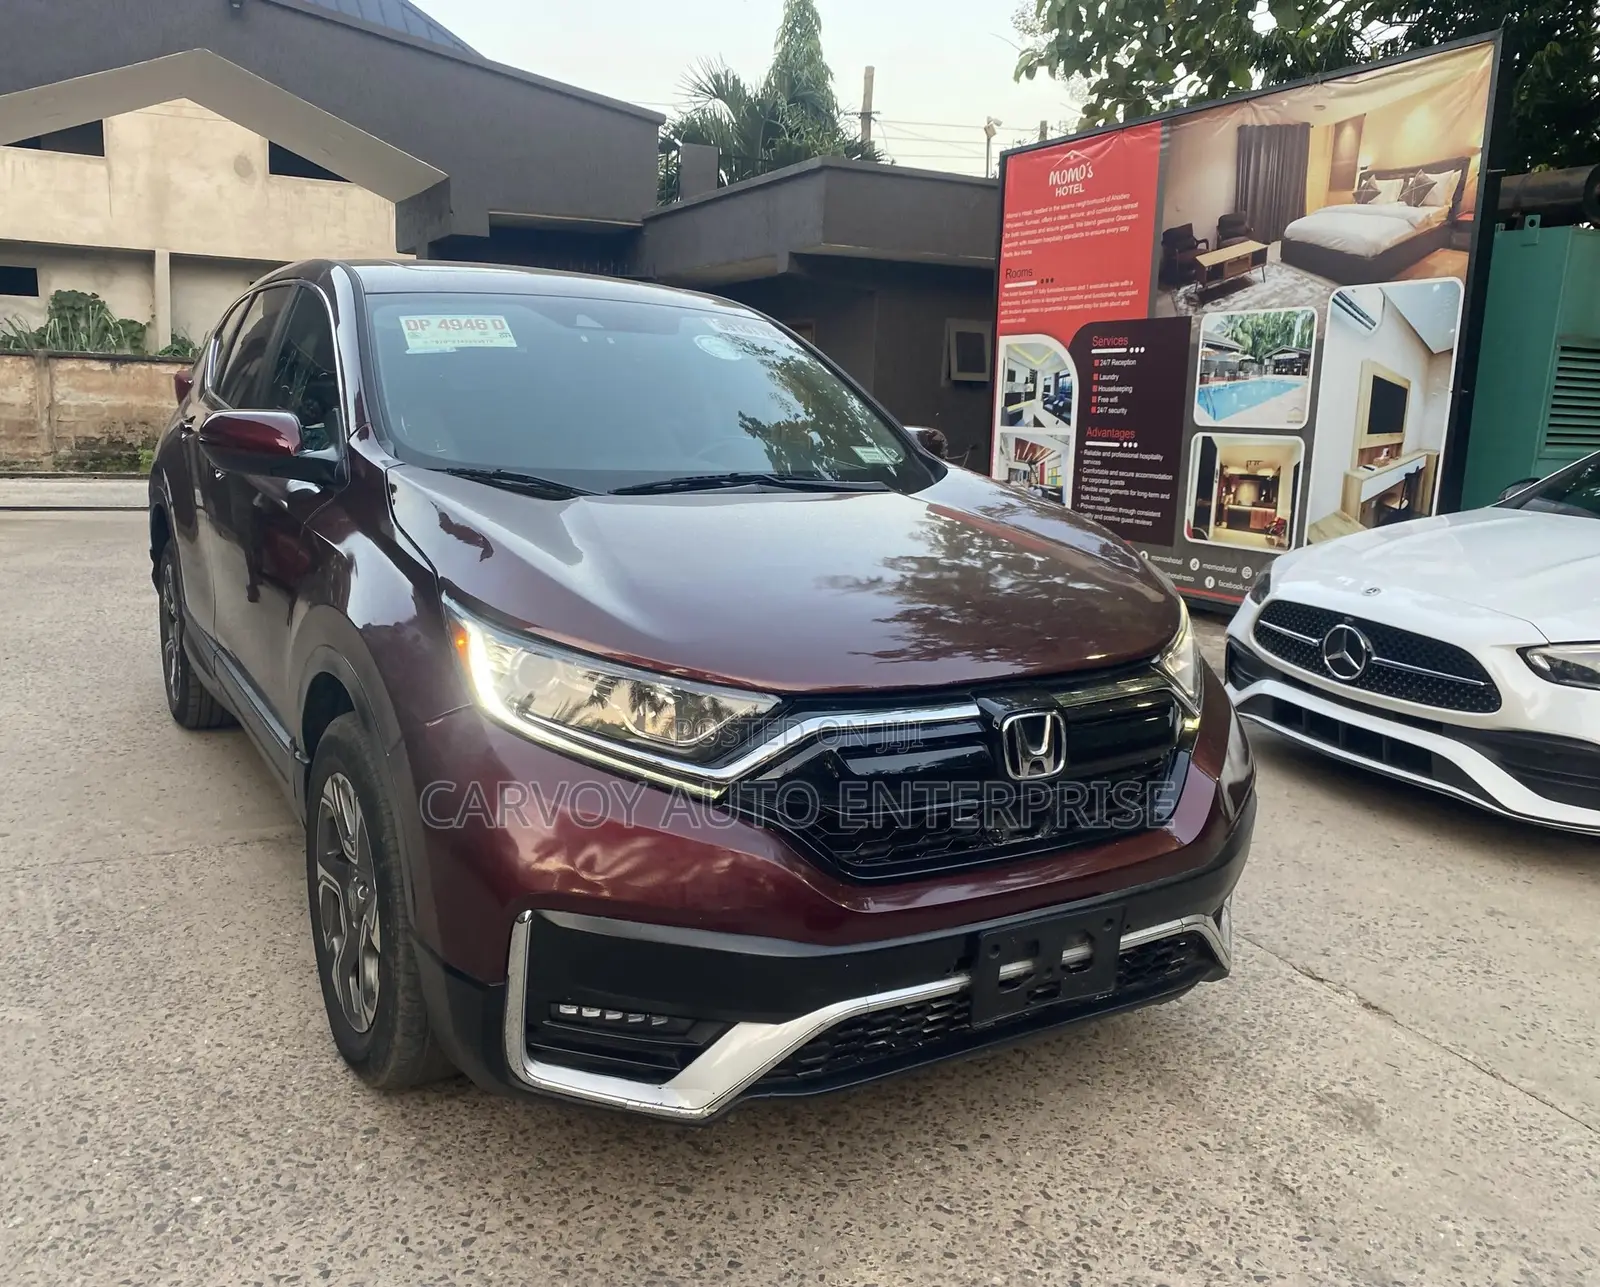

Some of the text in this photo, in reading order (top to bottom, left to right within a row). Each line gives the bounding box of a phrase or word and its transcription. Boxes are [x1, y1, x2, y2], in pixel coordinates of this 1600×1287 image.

[1056, 184, 1085, 197] HOTEL
[1006, 268, 1032, 279] Rooms
[438, 319, 488, 330] 4946
[1092, 336, 1128, 346] Services
[1098, 385, 1133, 393] Housekeeping
[1108, 407, 1127, 415] security
[1086, 427, 1135, 440] Advantages
[1140, 453, 1163, 461] hospitality
[1082, 467, 1109, 475] Comfortable
[1135, 472, 1173, 480] accommodation
[1137, 490, 1159, 498] long-term
[1090, 495, 1110, 503] bookings
[1137, 509, 1161, 517] consistent
[1135, 518, 1152, 526] reviews
[1151, 555, 1237, 574] momoshotel momoshotel
